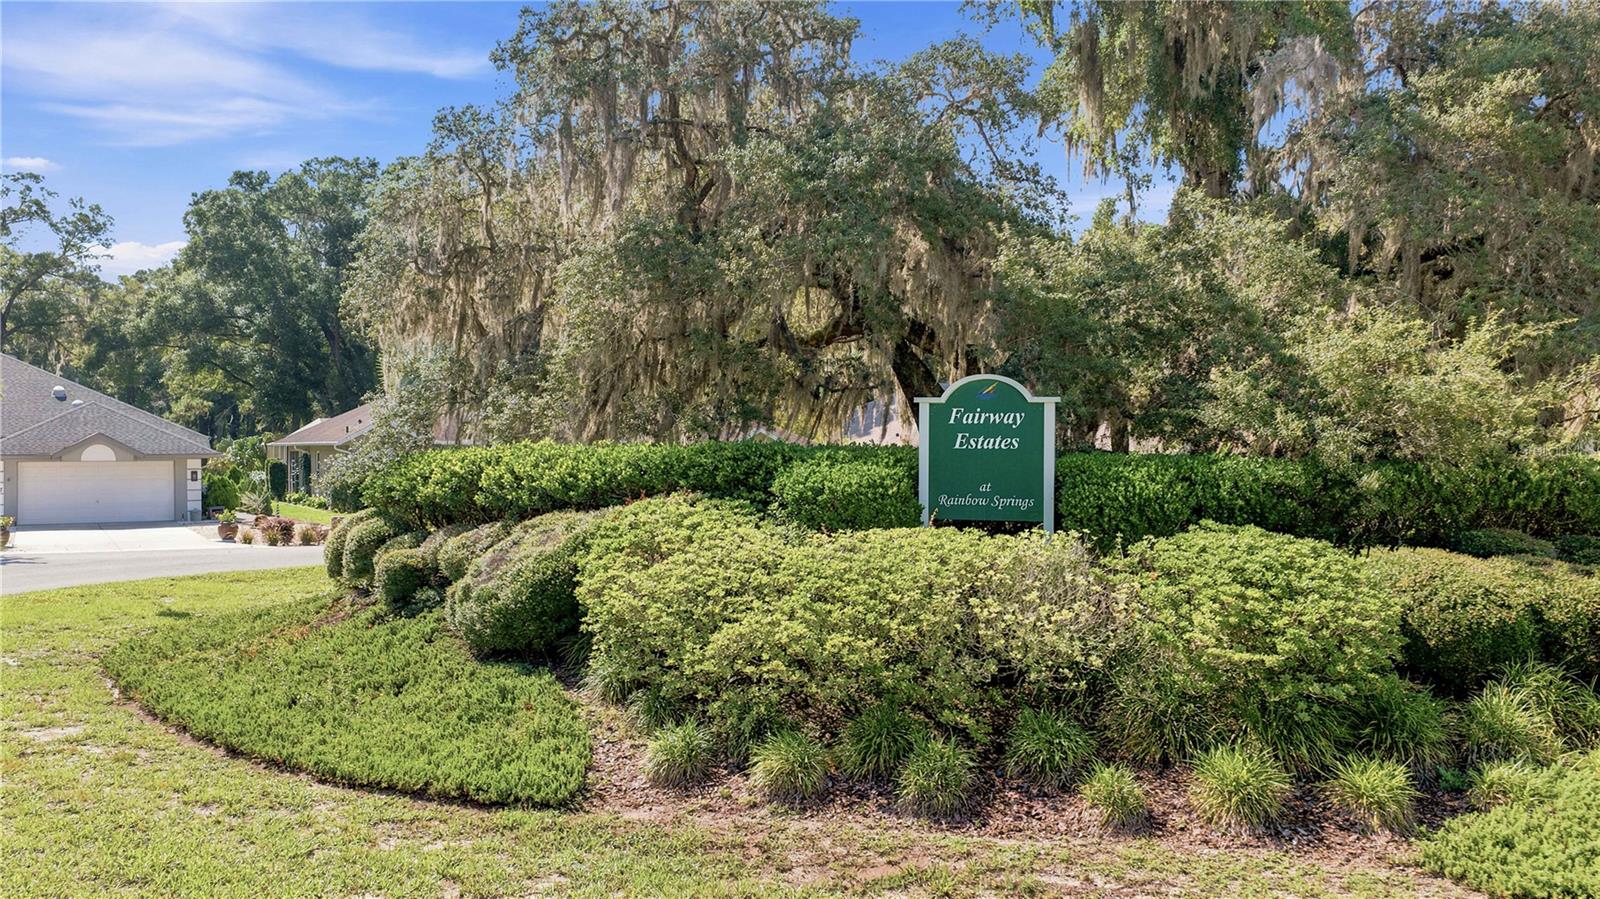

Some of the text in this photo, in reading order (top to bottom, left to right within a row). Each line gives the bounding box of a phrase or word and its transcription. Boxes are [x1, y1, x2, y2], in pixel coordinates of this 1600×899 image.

[948, 407, 1025, 428] Fairway
[953, 432, 1020, 450] Estates
[979, 482, 992, 492] at
[937, 493, 1034, 510] Rainbow Springs
